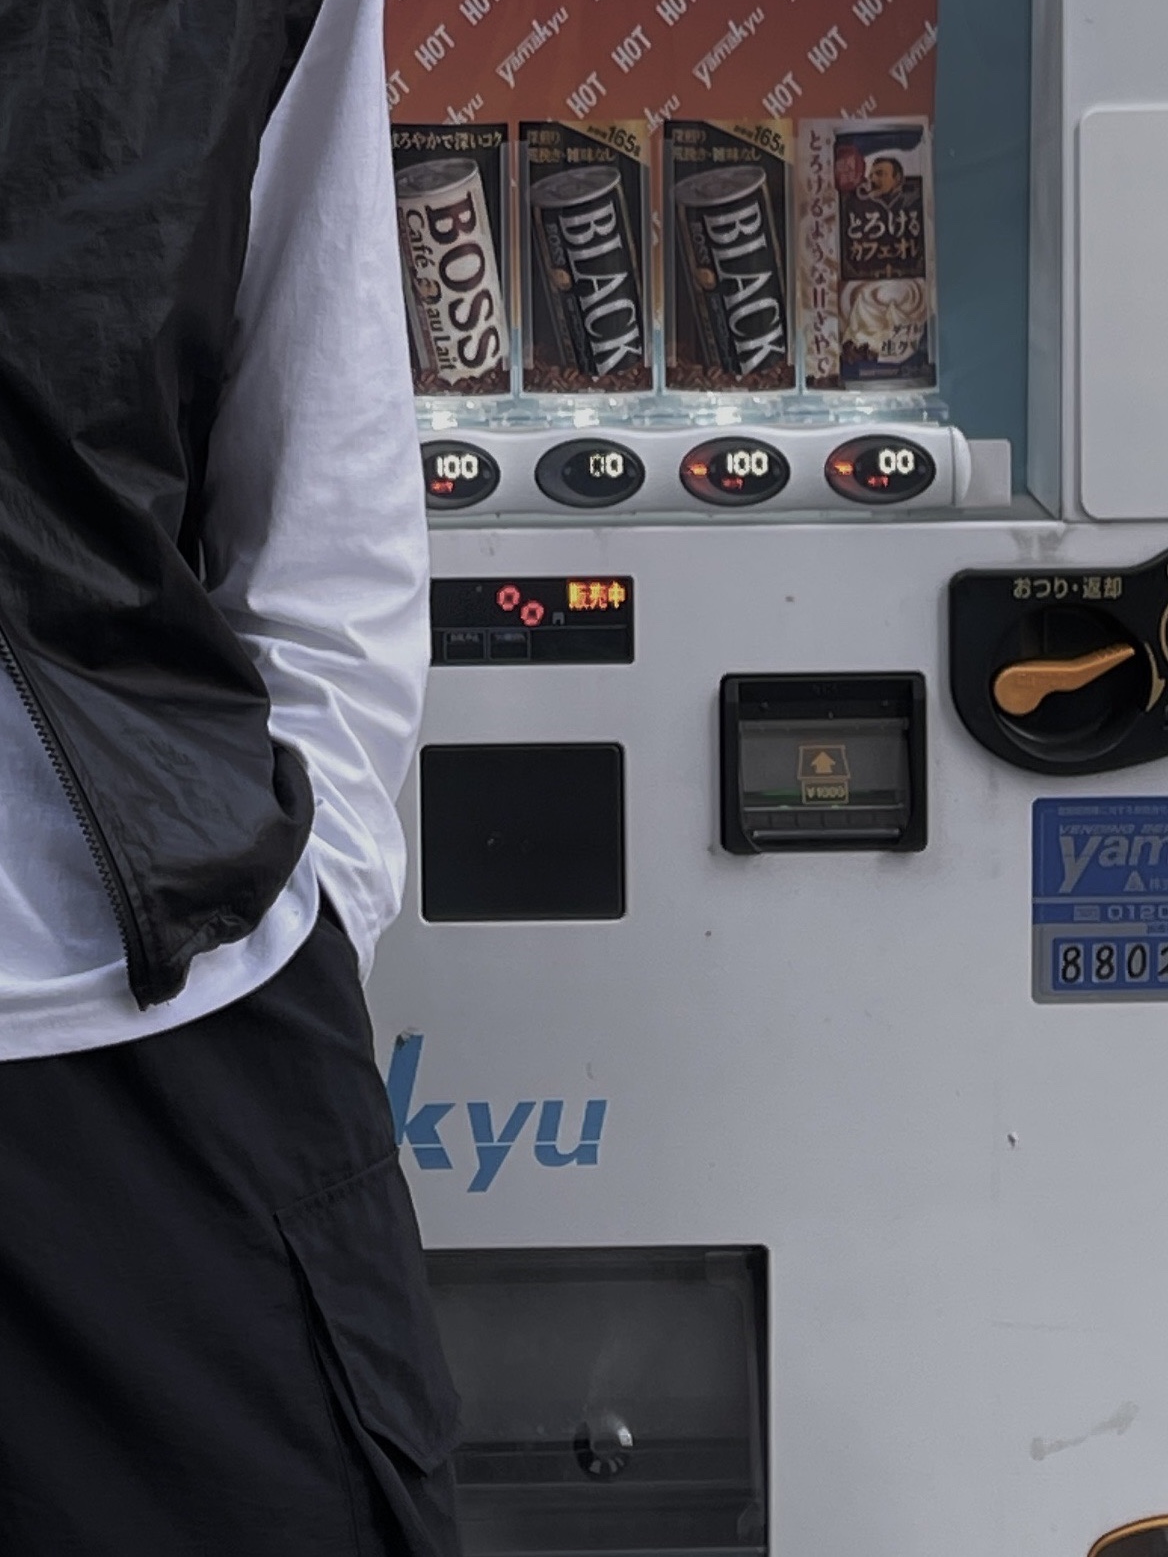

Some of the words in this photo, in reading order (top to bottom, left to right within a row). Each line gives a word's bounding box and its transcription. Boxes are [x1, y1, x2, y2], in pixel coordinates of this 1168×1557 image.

[414, 25, 455, 72] HOT
[496, 6, 569, 89] yamakyu
[611, 25, 653, 73] HOT
[691, 6, 765, 89] yamakyu
[807, 25, 848, 73] HOT
[566, 72, 608, 119] HOT
[762, 72, 803, 119] HOT
[847, 210, 920, 238] とろける
[850, 239, 917, 261] カフェオレ
[425, 190, 500, 368] BOSS
[558, 200, 642, 377] BLACK
[703, 200, 785, 376] BLACK
[437, 455, 478, 479] 100
[726, 451, 769, 476] 100
[568, 580, 626, 610] 販売中
[1013, 576, 1123, 599] おつり・返却
[387, 1035, 607, 1193] kyu
